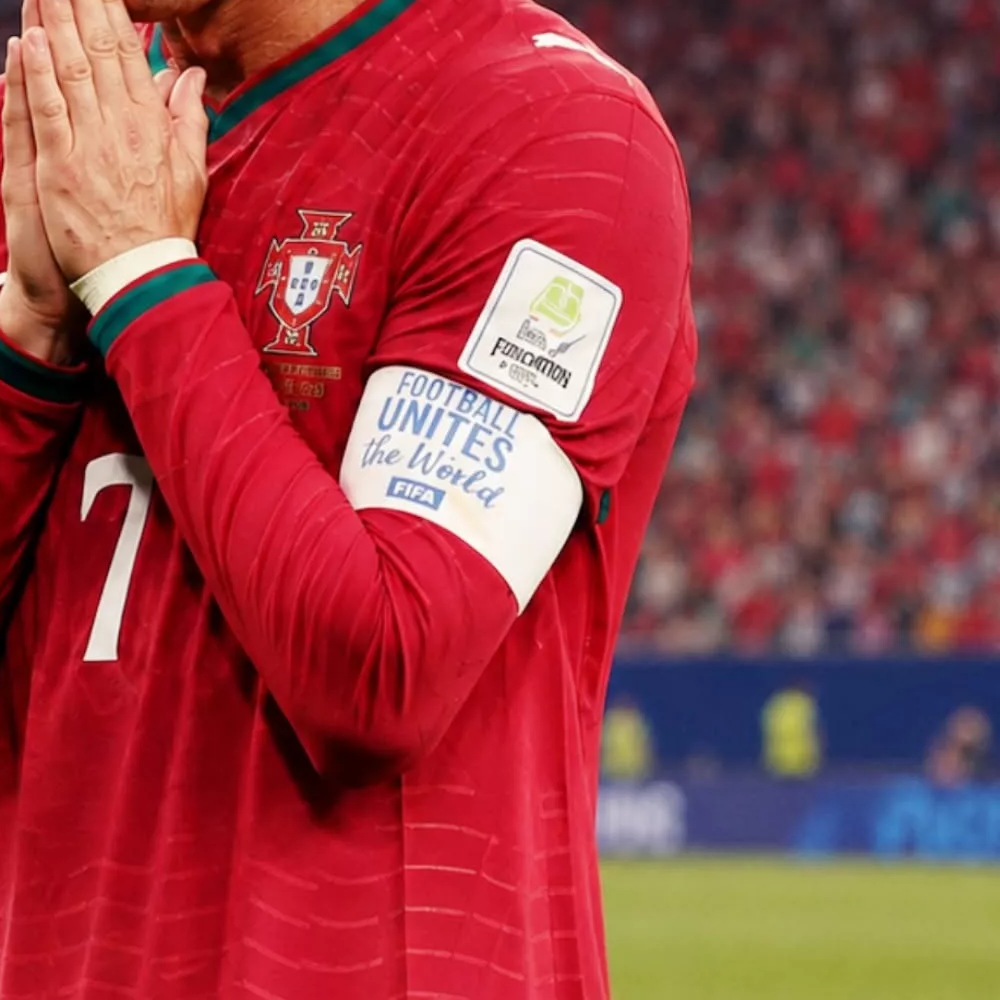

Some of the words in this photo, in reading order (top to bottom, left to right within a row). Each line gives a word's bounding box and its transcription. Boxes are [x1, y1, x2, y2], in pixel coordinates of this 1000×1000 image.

[377, 396, 514, 473] UNITES
[396, 371, 520, 440] FOOTBALL
[360, 434, 404, 469] the
[407, 442, 505, 509] World
[392, 480, 436, 506] FIFA
[80, 452, 154, 662] 7
